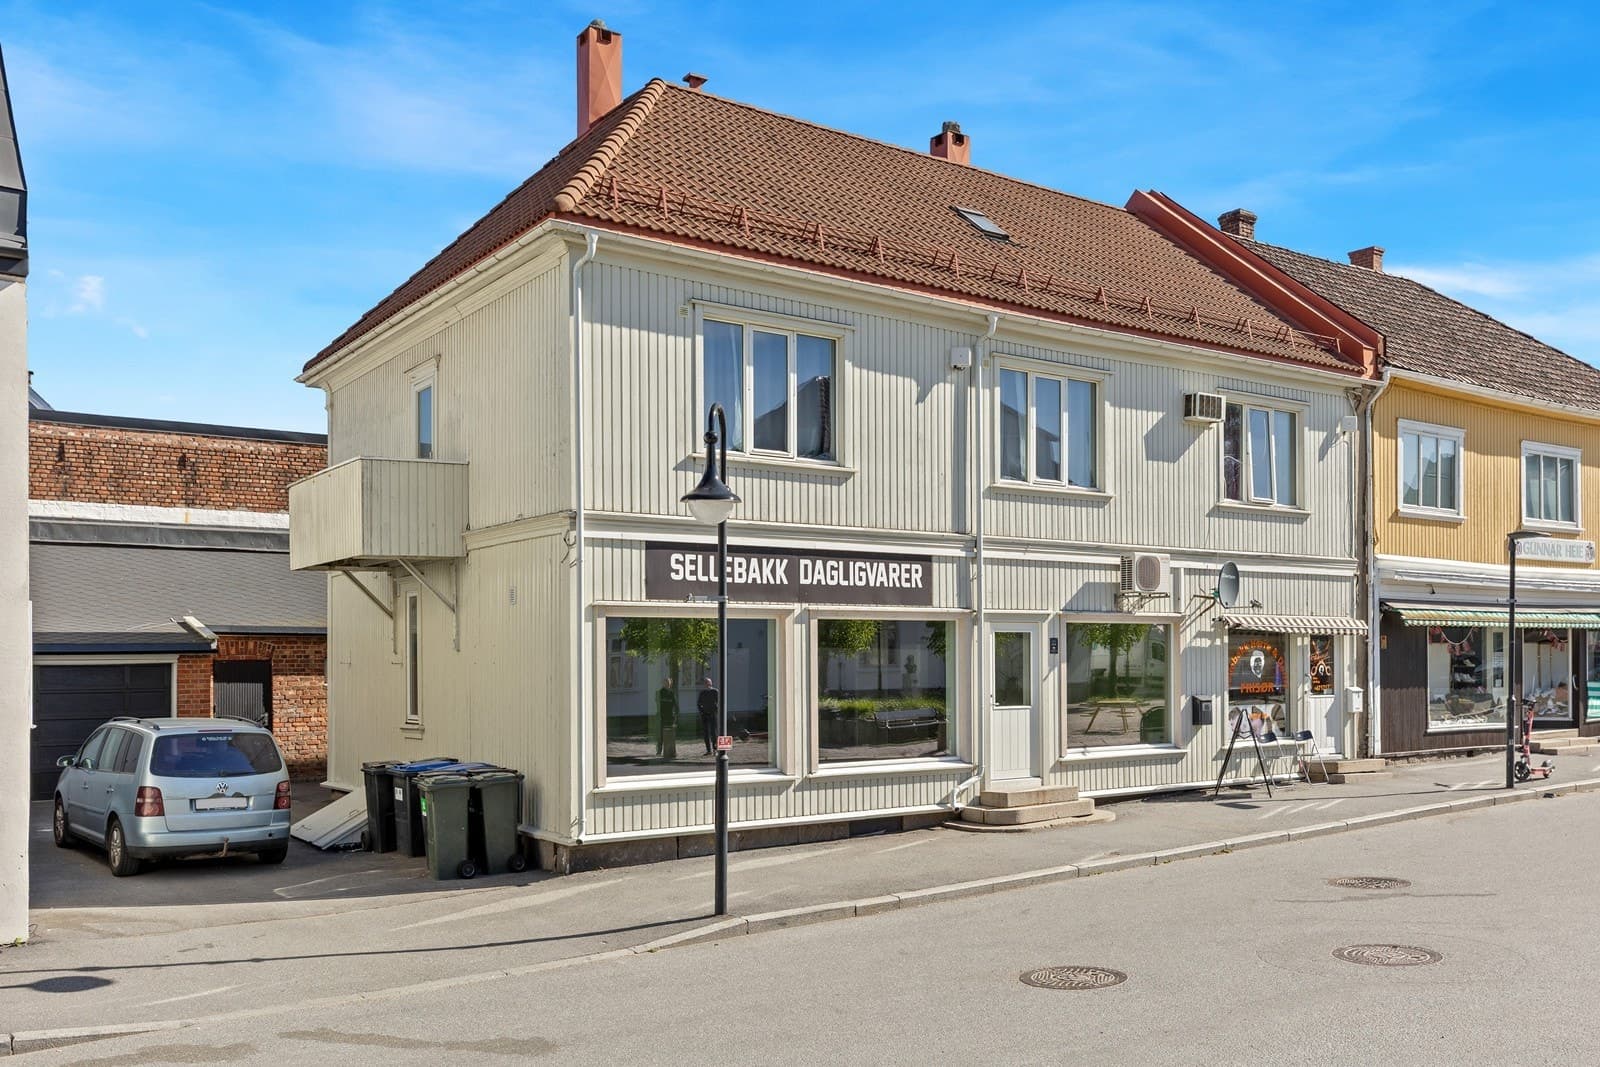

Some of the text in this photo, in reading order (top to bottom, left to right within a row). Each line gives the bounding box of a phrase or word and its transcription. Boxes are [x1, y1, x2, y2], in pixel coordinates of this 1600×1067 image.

[1523, 541, 1584, 558] GUNNAR HEIE
[799, 558, 923, 588] DAGLIGVARER
